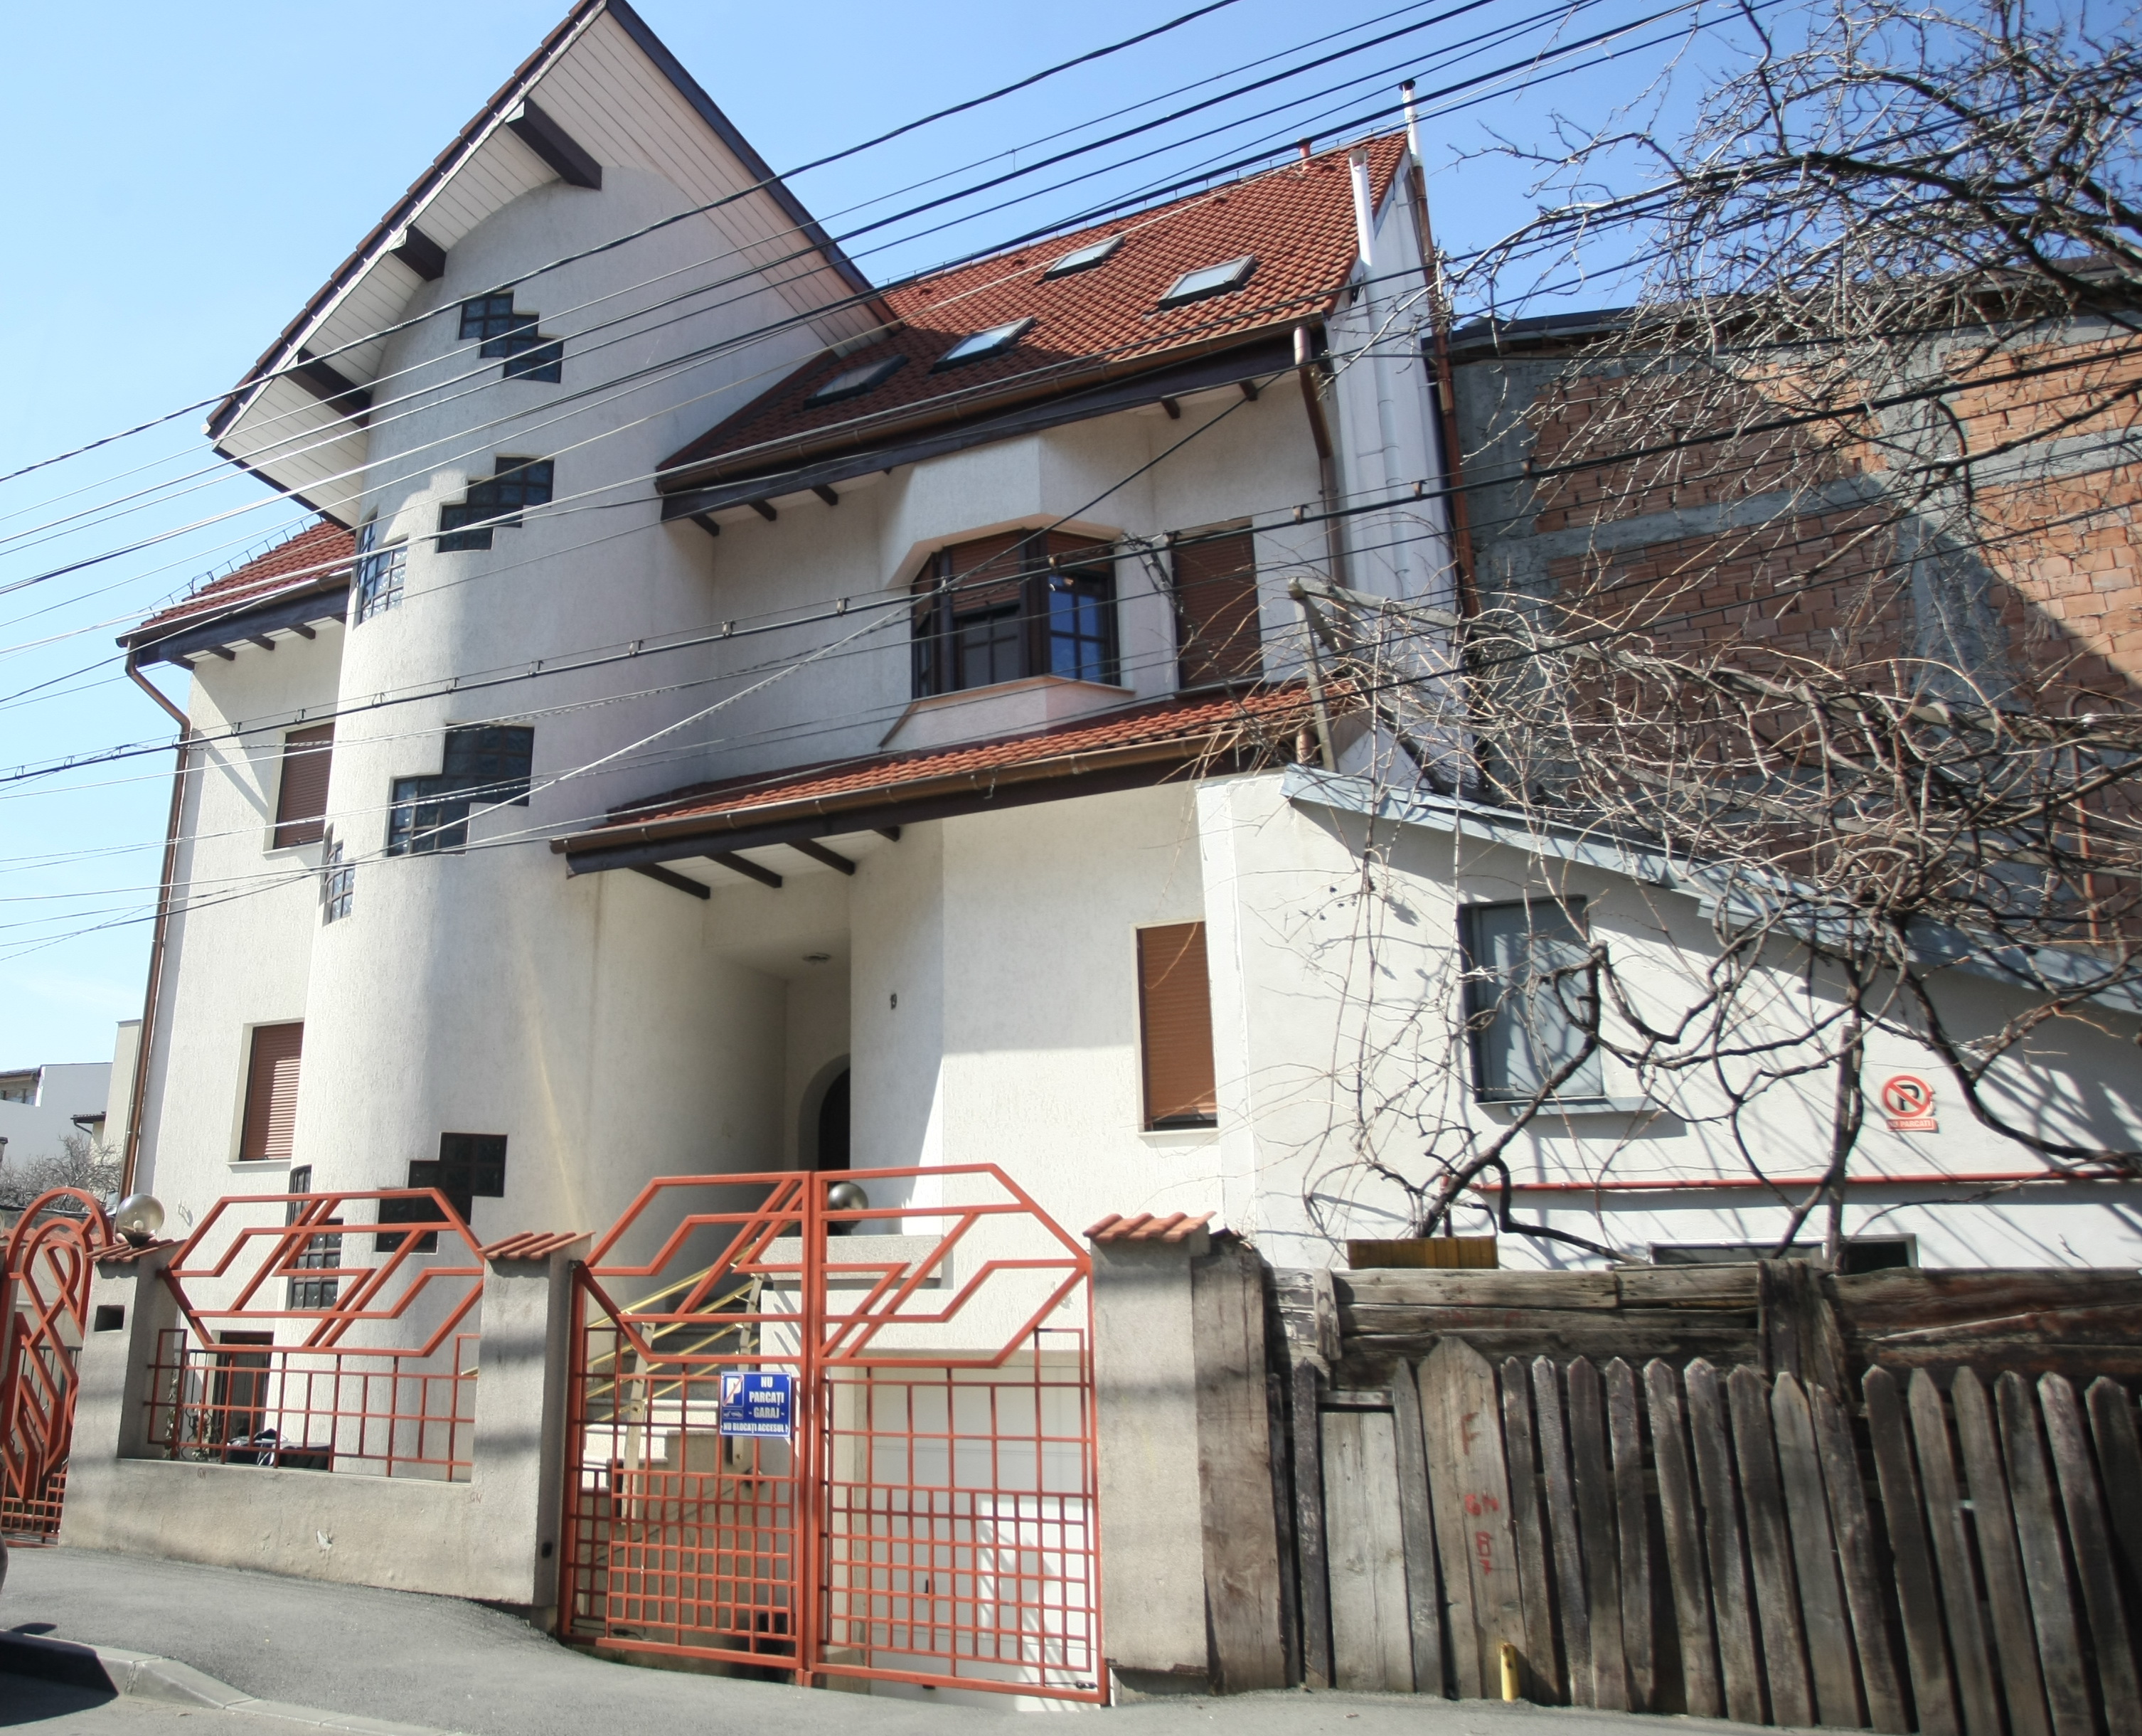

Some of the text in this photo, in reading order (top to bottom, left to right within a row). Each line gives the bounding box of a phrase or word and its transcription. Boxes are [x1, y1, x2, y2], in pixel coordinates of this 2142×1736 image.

[760, 1376, 773, 1388] NU
[754, 1407, 779, 1419] GARAJ
[723, 1422, 732, 1431] NU
[757, 1423, 784, 1433] ACCESUL
